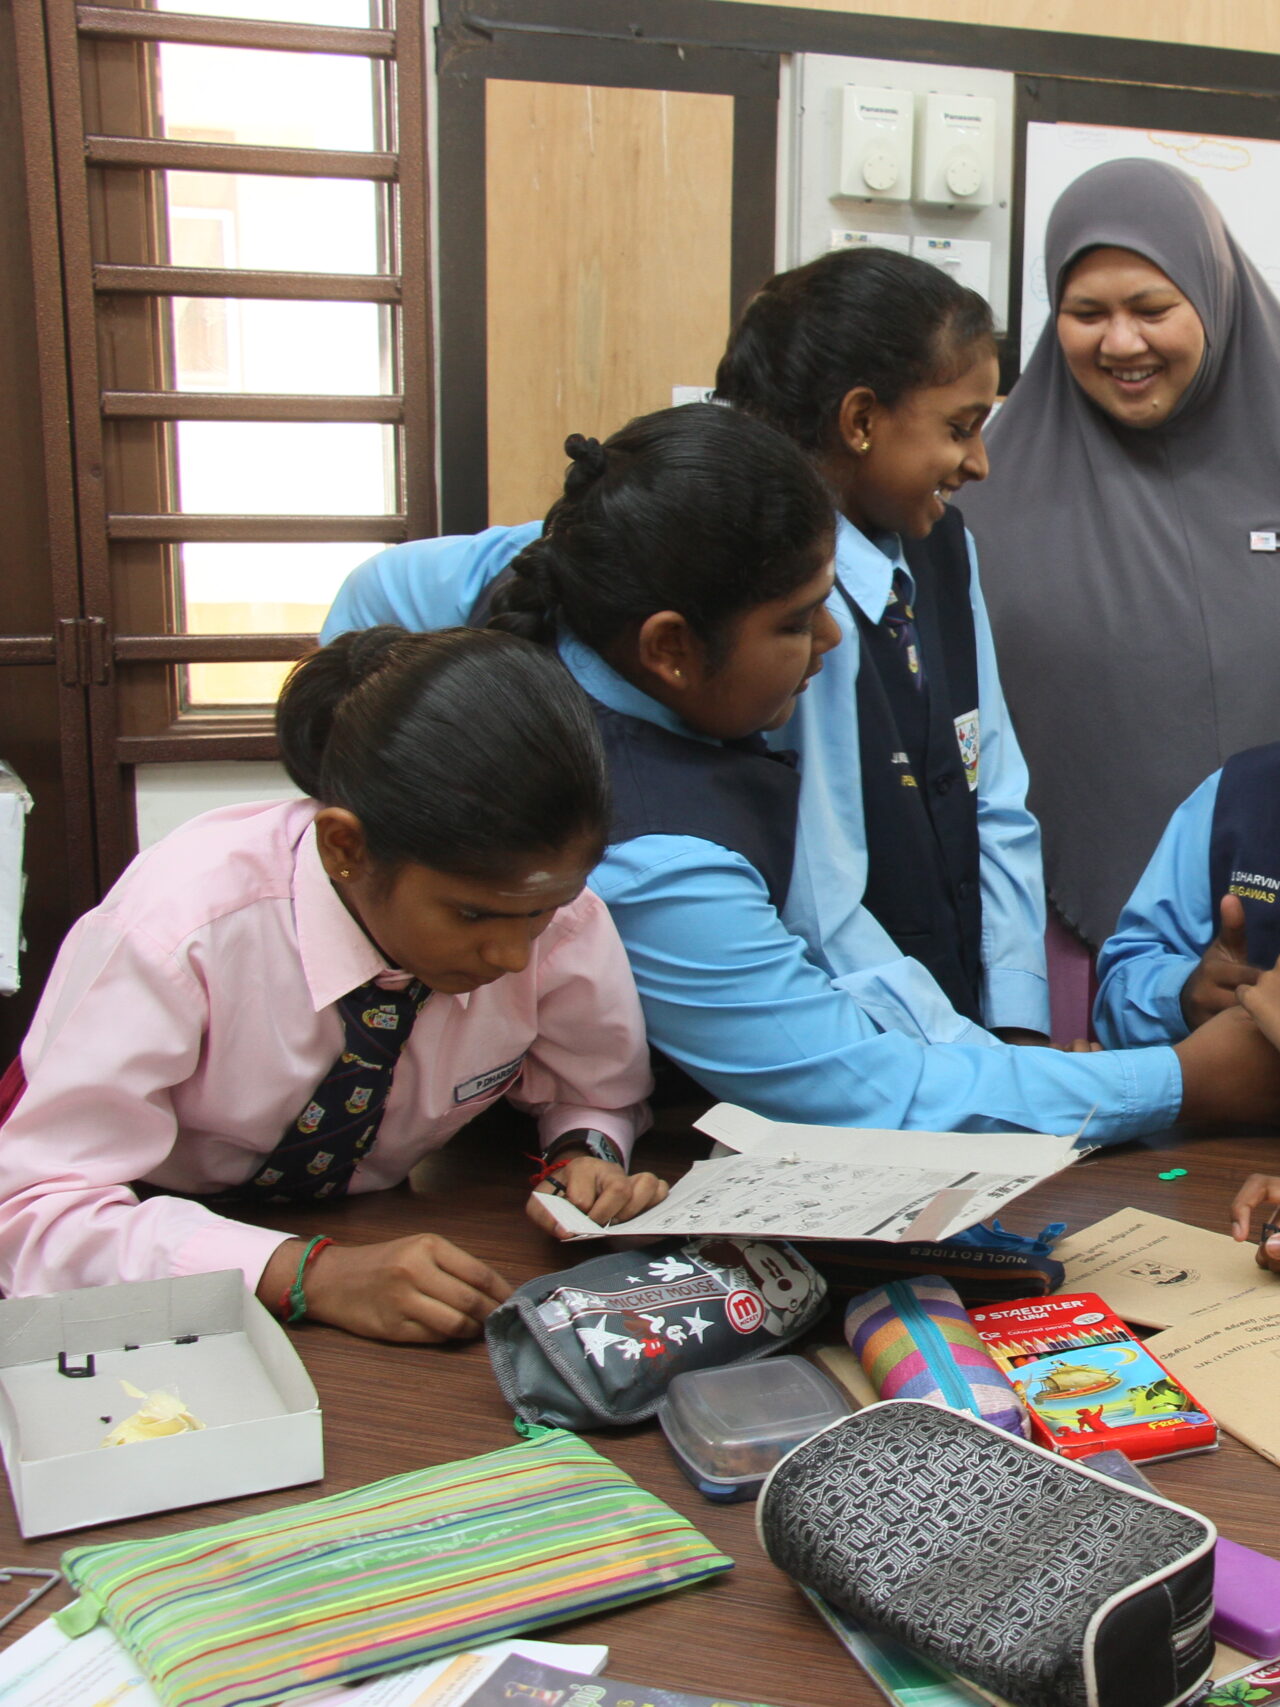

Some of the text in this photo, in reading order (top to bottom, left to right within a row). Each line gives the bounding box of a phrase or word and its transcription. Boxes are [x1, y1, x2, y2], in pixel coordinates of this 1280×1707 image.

[860, 105, 898, 115] Panasonic
[944, 112, 982, 122] Panasonic
[910, 1247, 1028, 1264] NUCLEOTIDES
[608, 1280, 718, 1309] MICKEY MOUSE
[989, 1300, 1085, 1321] STAEDTLER
[1016, 1312, 1050, 1322] LUNA
[1007, 1323, 1072, 1336] Coloured pencils
[1148, 1417, 1185, 1430] FREE!
